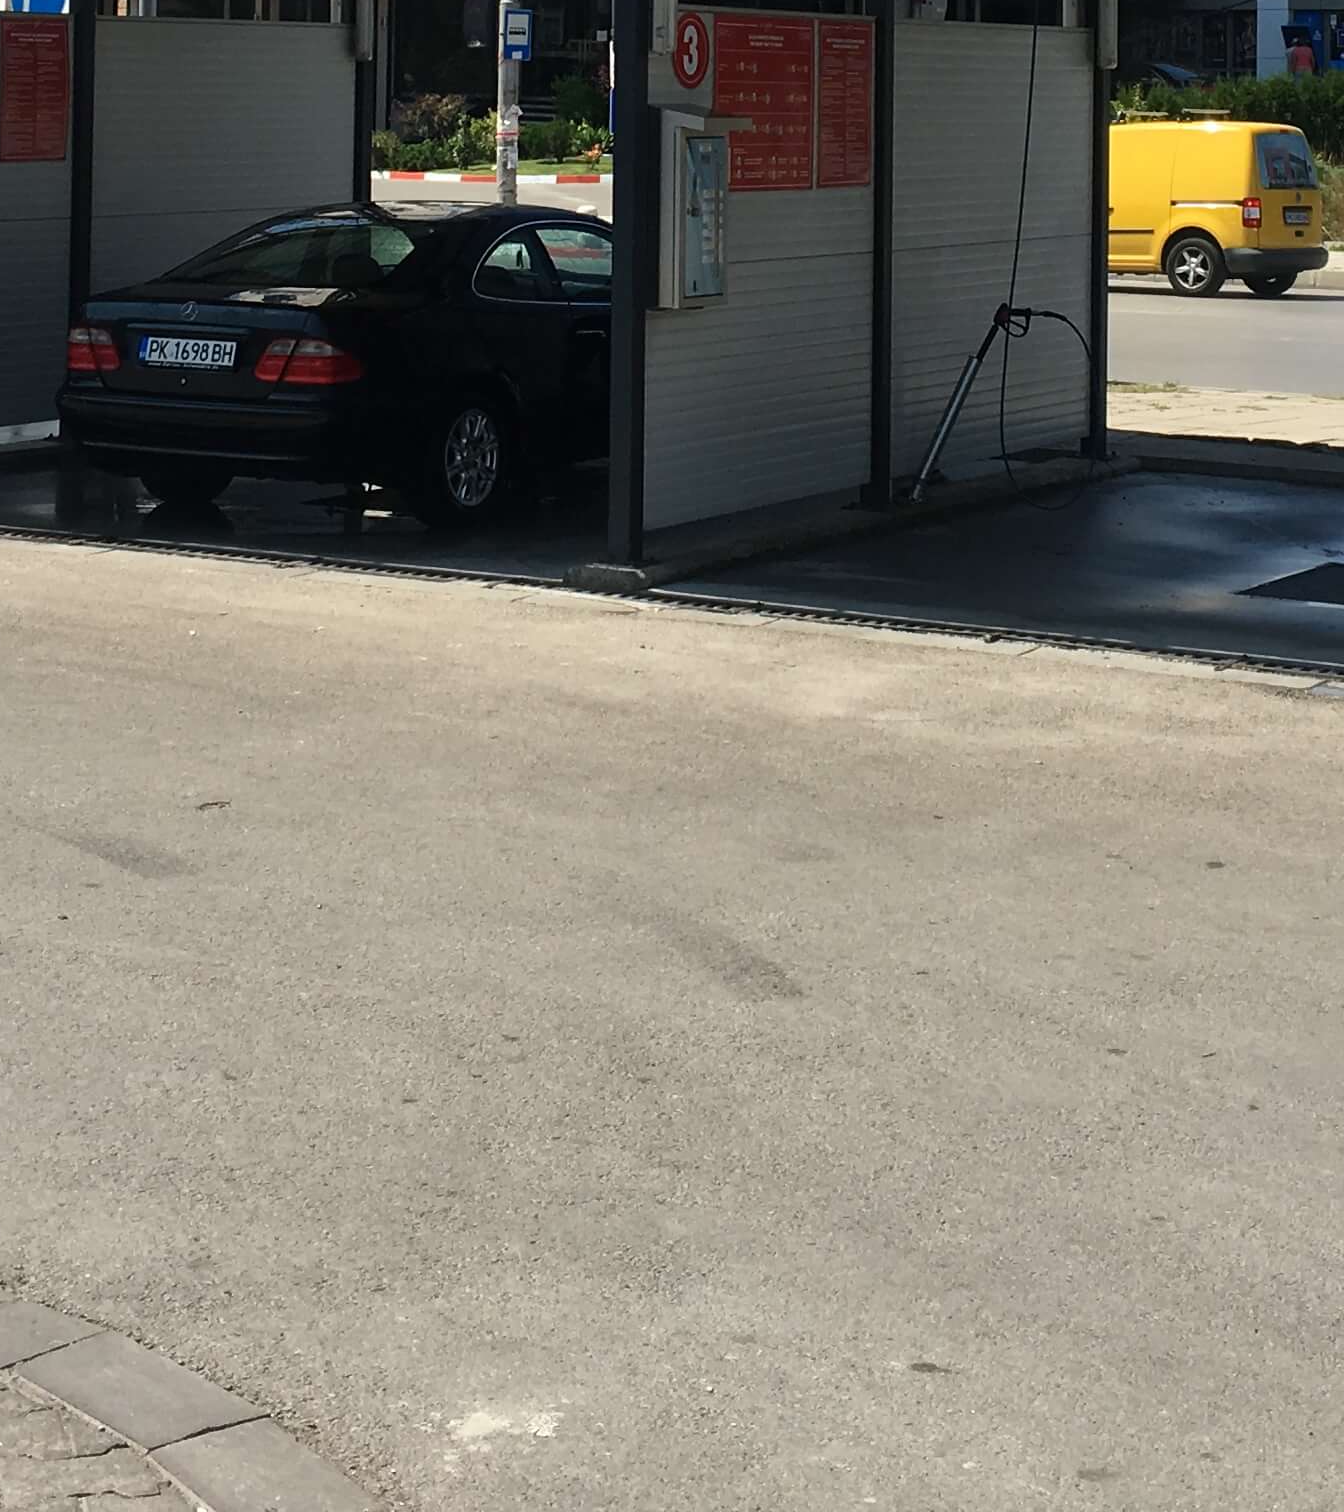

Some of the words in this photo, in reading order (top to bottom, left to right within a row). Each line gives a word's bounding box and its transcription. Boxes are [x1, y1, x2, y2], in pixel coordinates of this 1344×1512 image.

[683, 25, 699, 76] 3
[148, 340, 170, 360] PK
[174, 341, 210, 362] 1698
[211, 343, 234, 363] BH
